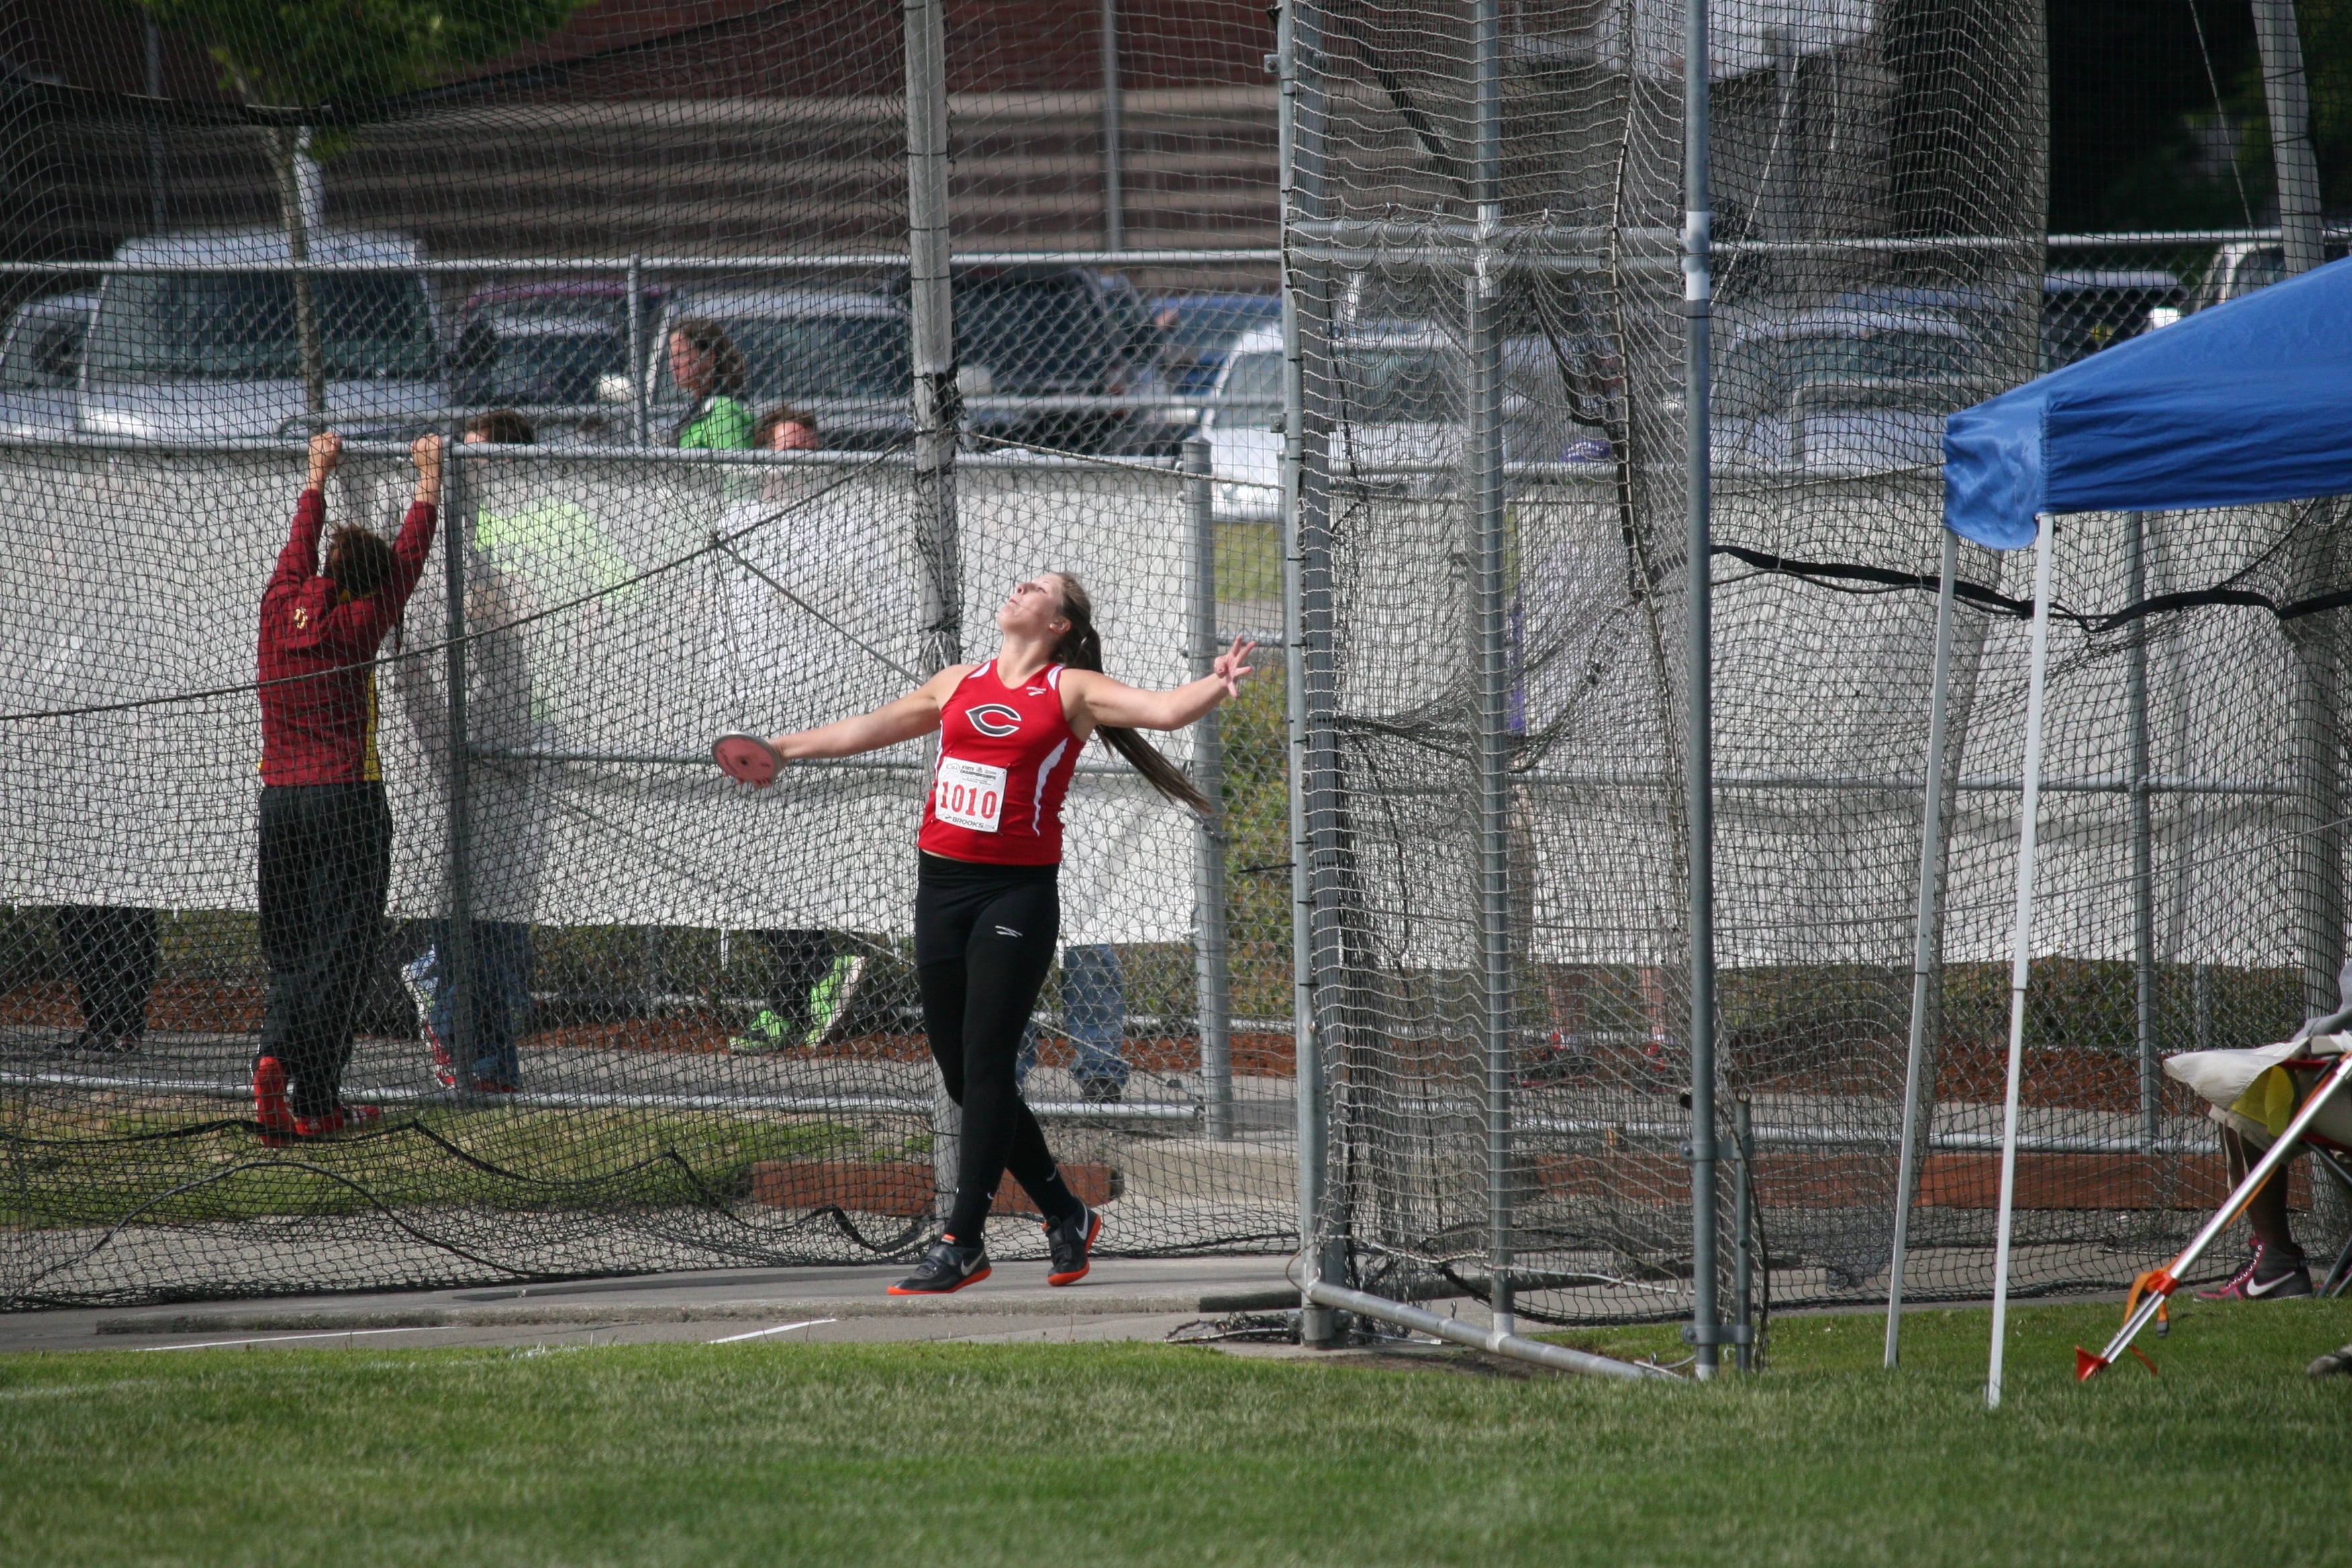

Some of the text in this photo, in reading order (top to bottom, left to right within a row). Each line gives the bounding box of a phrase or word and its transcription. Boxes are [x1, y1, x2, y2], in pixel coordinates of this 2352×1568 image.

[965, 703, 1022, 737] C
[940, 781, 997, 820] 1010
[952, 816, 985, 828] BROOKS
